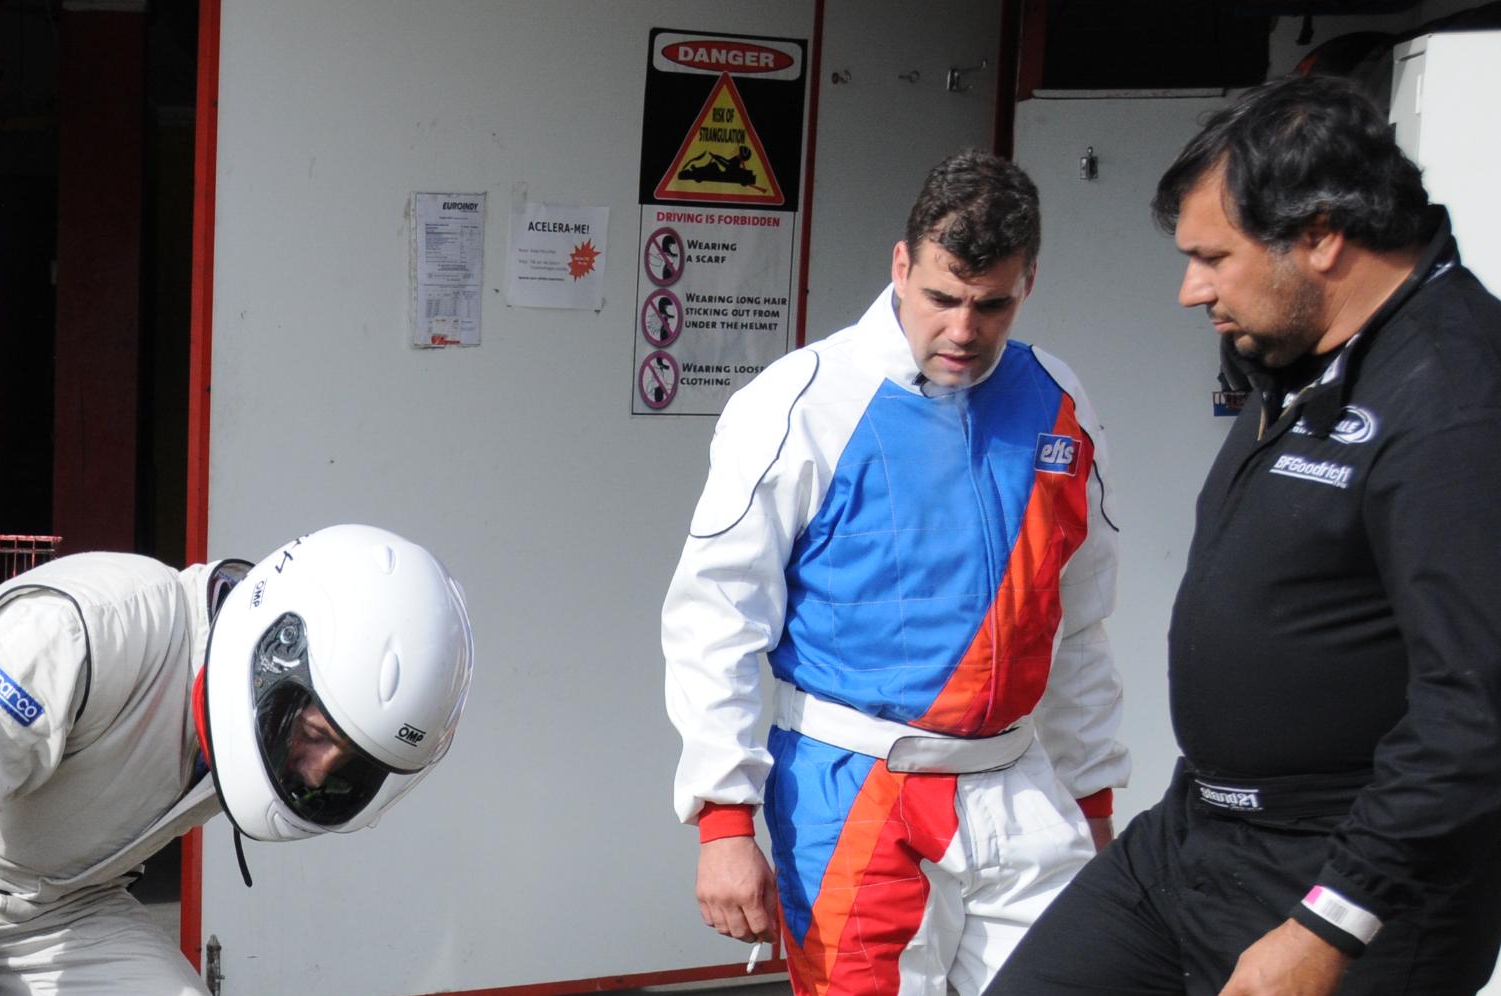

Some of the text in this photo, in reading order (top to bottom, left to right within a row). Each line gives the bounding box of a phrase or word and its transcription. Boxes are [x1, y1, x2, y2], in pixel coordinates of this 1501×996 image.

[677, 45, 775, 68] DANGER
[712, 107, 735, 123] RISK OF
[699, 126, 746, 145] STRANGULATION
[656, 211, 781, 227] DRIVING IS FORBIDDEN
[527, 220, 591, 235] ACELERA-ME!
[686, 239, 738, 252] WEARING
[686, 255, 727, 264] A SCARF
[685, 292, 788, 306] WEARING LONG HAIR
[684, 307, 780, 318] STICKING OUT FROM
[684, 320, 779, 331] UNDER THE HELMET
[681, 363, 731, 374] WEARING
[680, 376, 731, 387] CLOTHING
[398, 726, 424, 744] OMP
